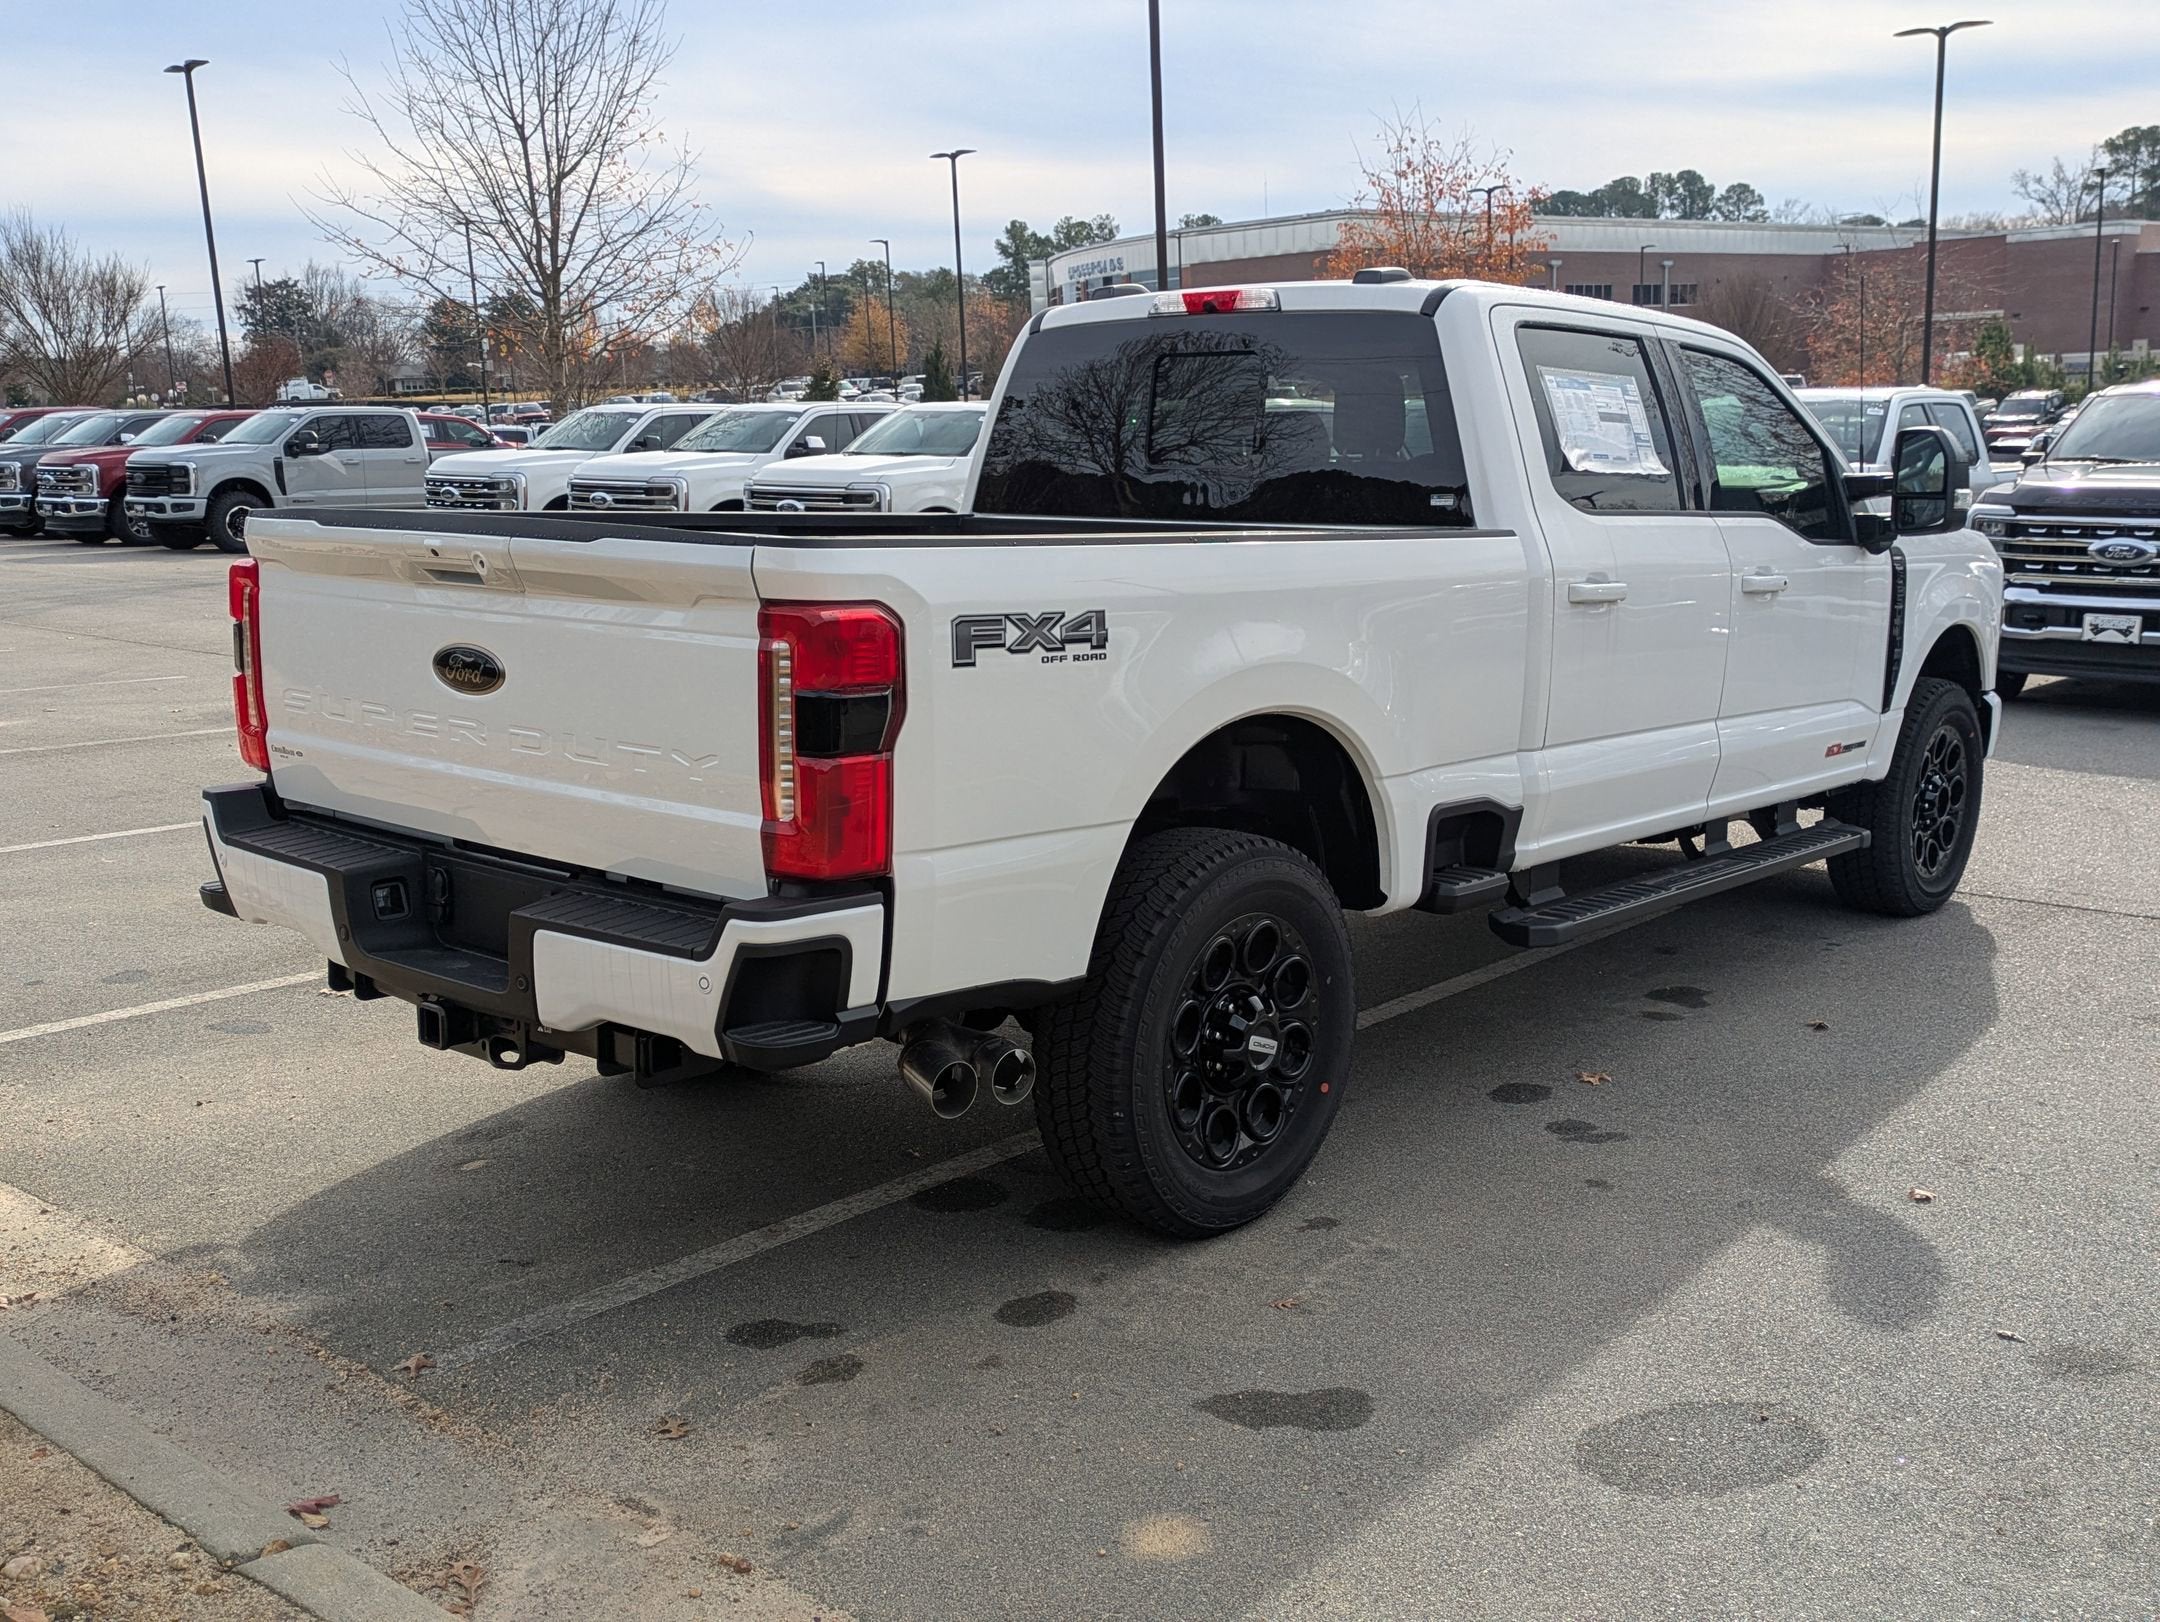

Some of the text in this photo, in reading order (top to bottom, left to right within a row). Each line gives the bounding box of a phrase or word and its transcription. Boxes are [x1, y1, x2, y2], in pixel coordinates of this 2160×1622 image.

[2105, 545, 2137, 559] Ford
[951, 610, 1108, 668] FX4
[445, 653, 484, 684] Ford
[1041, 652, 1107, 664] OFF ROAD
[283, 688, 718, 781] SUPER DUTY
